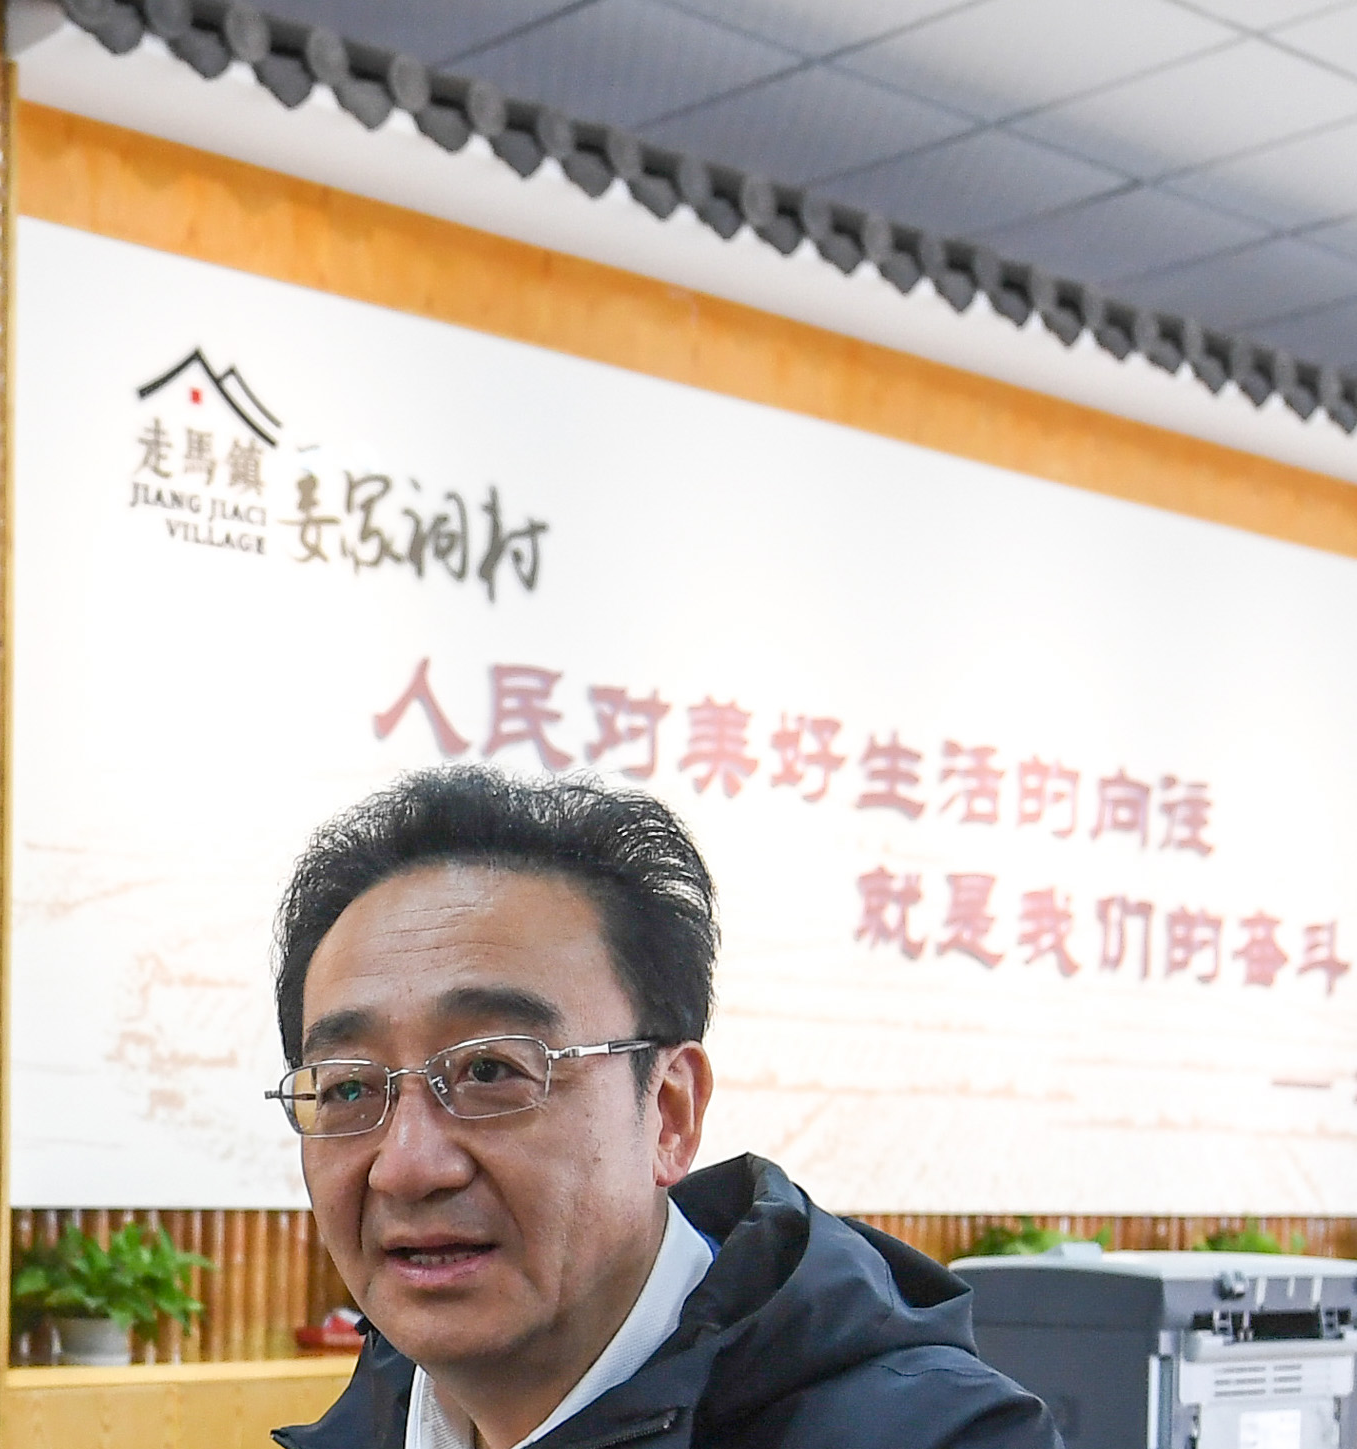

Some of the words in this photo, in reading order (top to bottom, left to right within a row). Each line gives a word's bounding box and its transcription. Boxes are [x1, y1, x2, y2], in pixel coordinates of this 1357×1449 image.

[130, 482, 202, 513] JIANG
[164, 518, 267, 555] VILLAGE
[373, 656, 1215, 857] 人民对美好生活的向往
[854, 865, 1353, 998] 就是我们的奋斗
